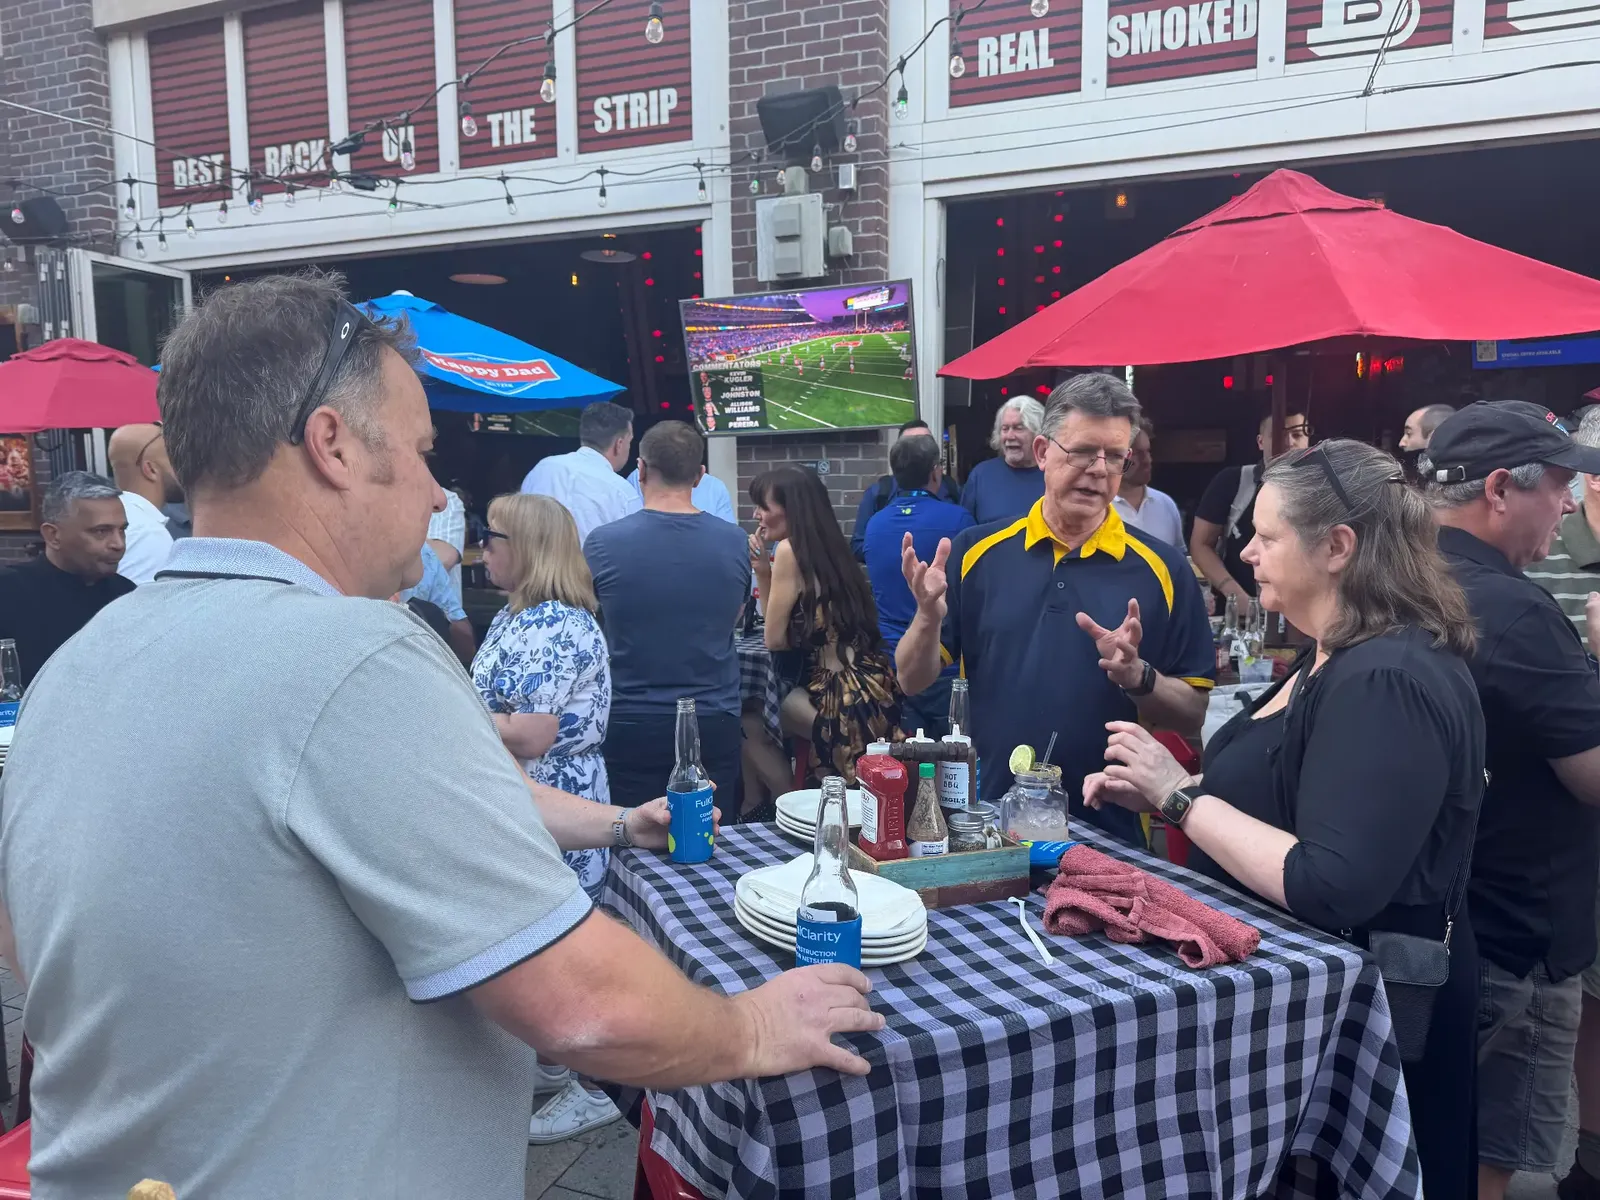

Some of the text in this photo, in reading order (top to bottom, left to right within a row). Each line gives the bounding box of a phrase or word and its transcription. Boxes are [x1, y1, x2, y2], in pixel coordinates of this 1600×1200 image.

[978, 28, 1054, 78] REAL
[1108, 0, 1257, 58] SMOKED
[172, 153, 225, 191] BEST
[487, 108, 537, 147] THE
[593, 87, 678, 134] STRIP
[430, 356, 546, 378] Happy Dad
[692, 360, 761, 371] COMMENTATORS
[724, 375, 753, 383] KUGLER
[721, 390, 760, 399] JOHNSTON
[724, 405, 760, 414] WILLIAMS
[728, 420, 759, 428] PEREIRA
[944, 773, 958, 781] HOT
[943, 781, 959, 789] BBQ
